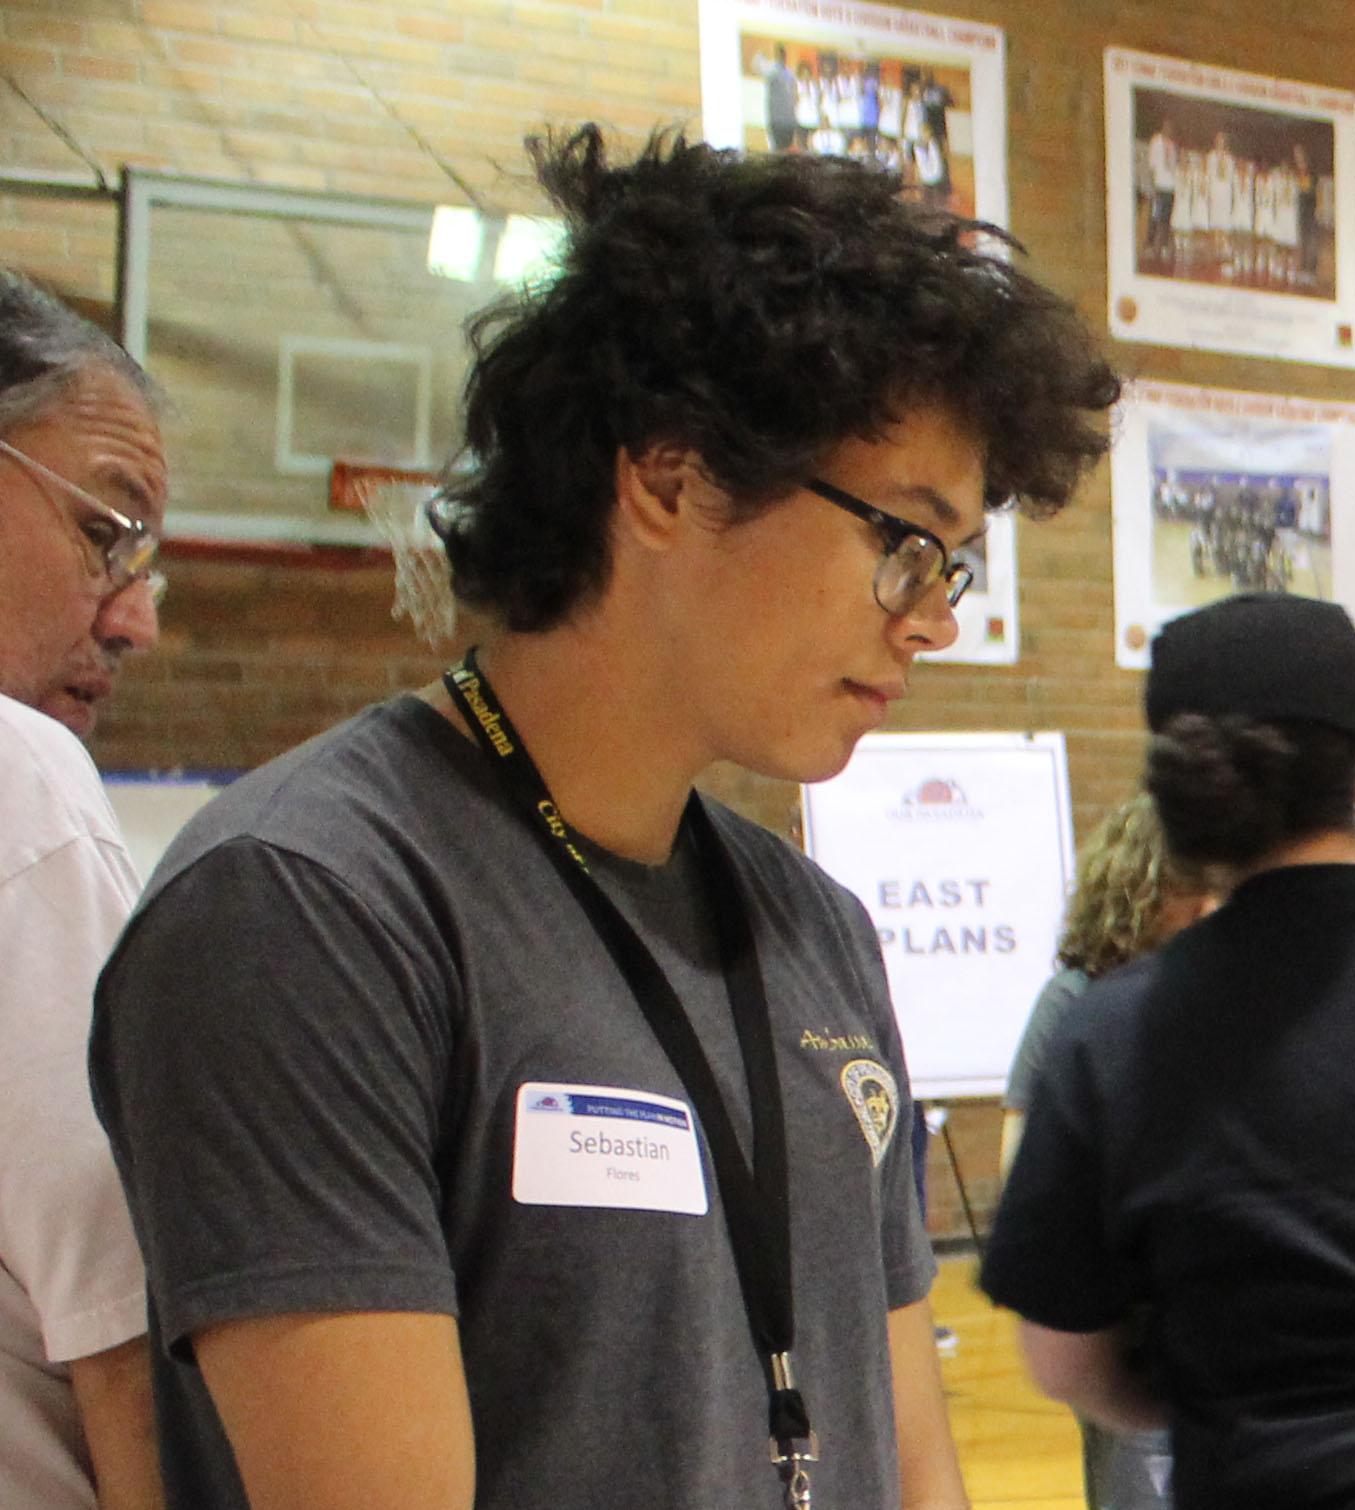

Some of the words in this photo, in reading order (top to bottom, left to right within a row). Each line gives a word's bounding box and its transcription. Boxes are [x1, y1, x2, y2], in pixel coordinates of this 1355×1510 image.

[537, 799, 568, 839] City
[877, 878, 992, 908] EAST
[879, 925, 1018, 954] PLANS
[569, 1130, 671, 1161] Sebastian
[606, 1166, 641, 1182] Flores
